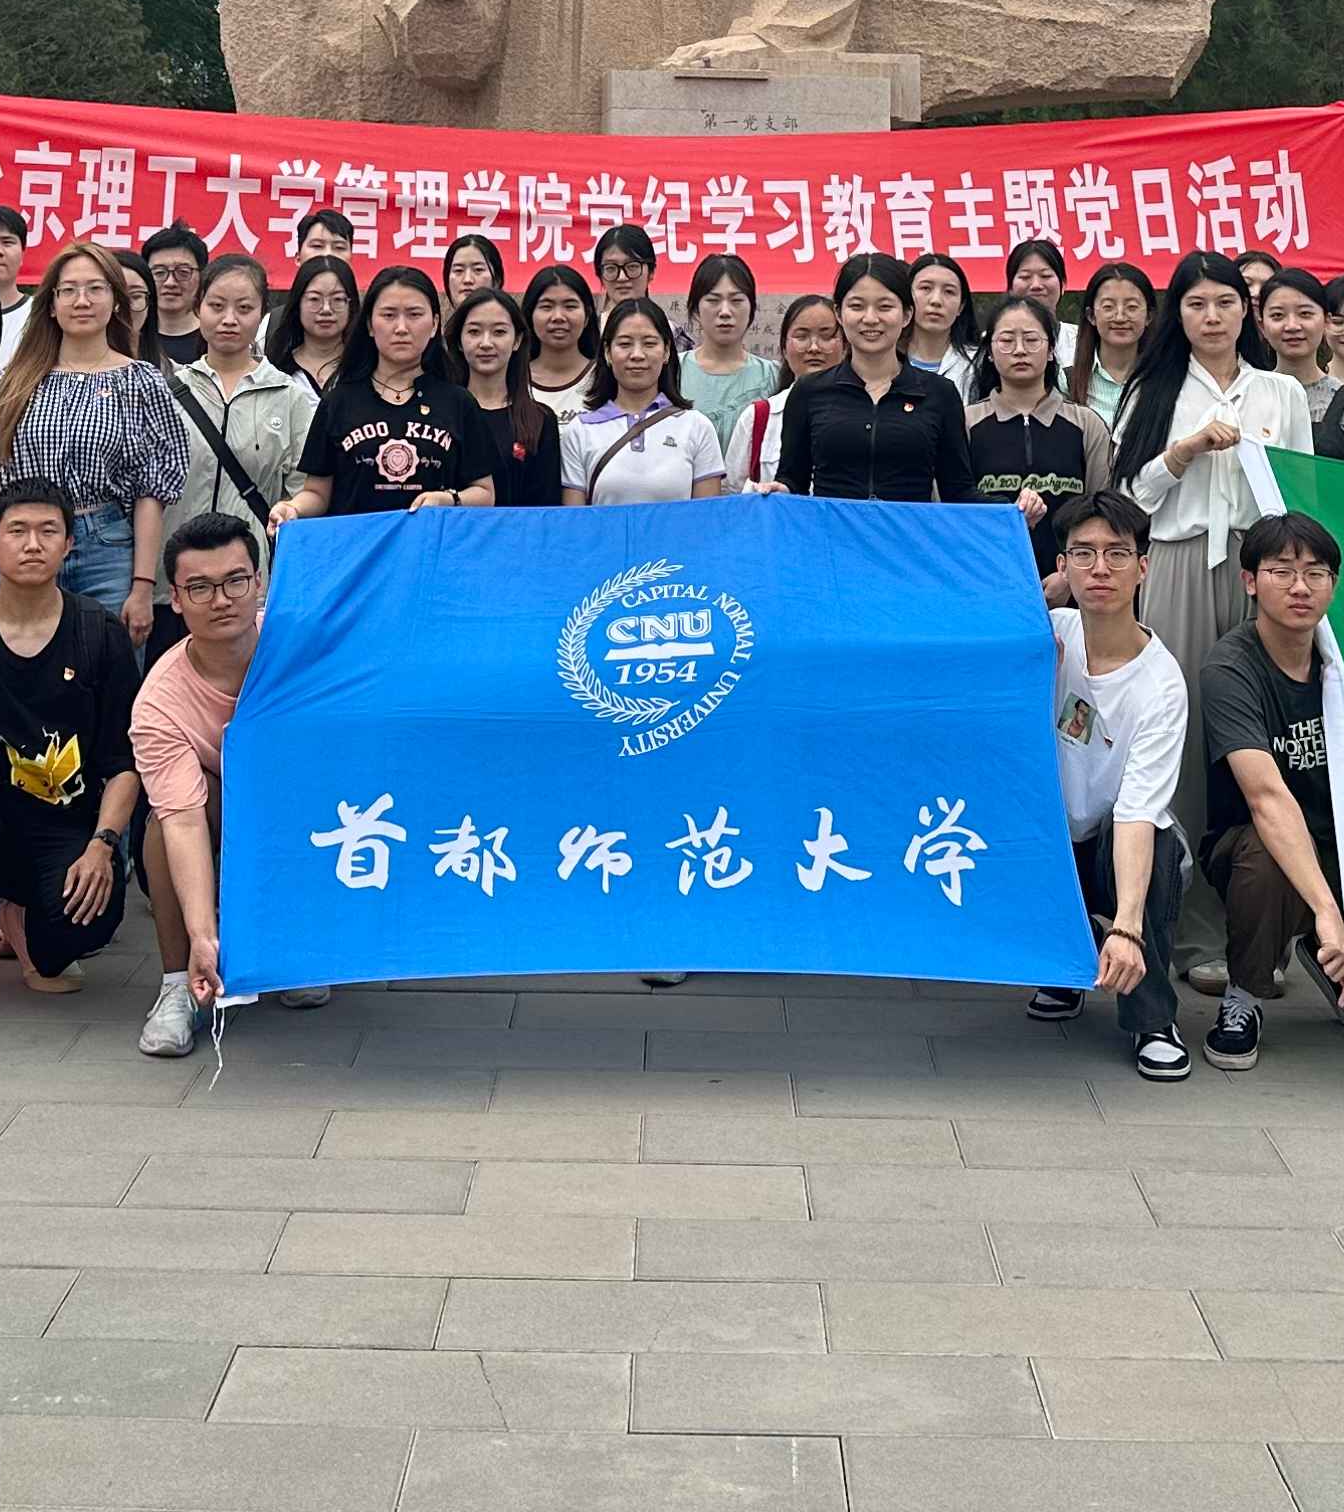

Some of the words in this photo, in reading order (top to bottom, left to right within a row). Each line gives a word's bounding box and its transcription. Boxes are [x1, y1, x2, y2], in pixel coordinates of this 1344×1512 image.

[621, 583, 708, 609] CAPITAL
[606, 609, 712, 644] CNU
[712, 592, 754, 664] NORMAL
[614, 660, 698, 685] 1954
[618, 670, 742, 757] UNIVERSITY
[1289, 717, 1322, 738] THE
[309, 792, 988, 906] 首都师范大学
